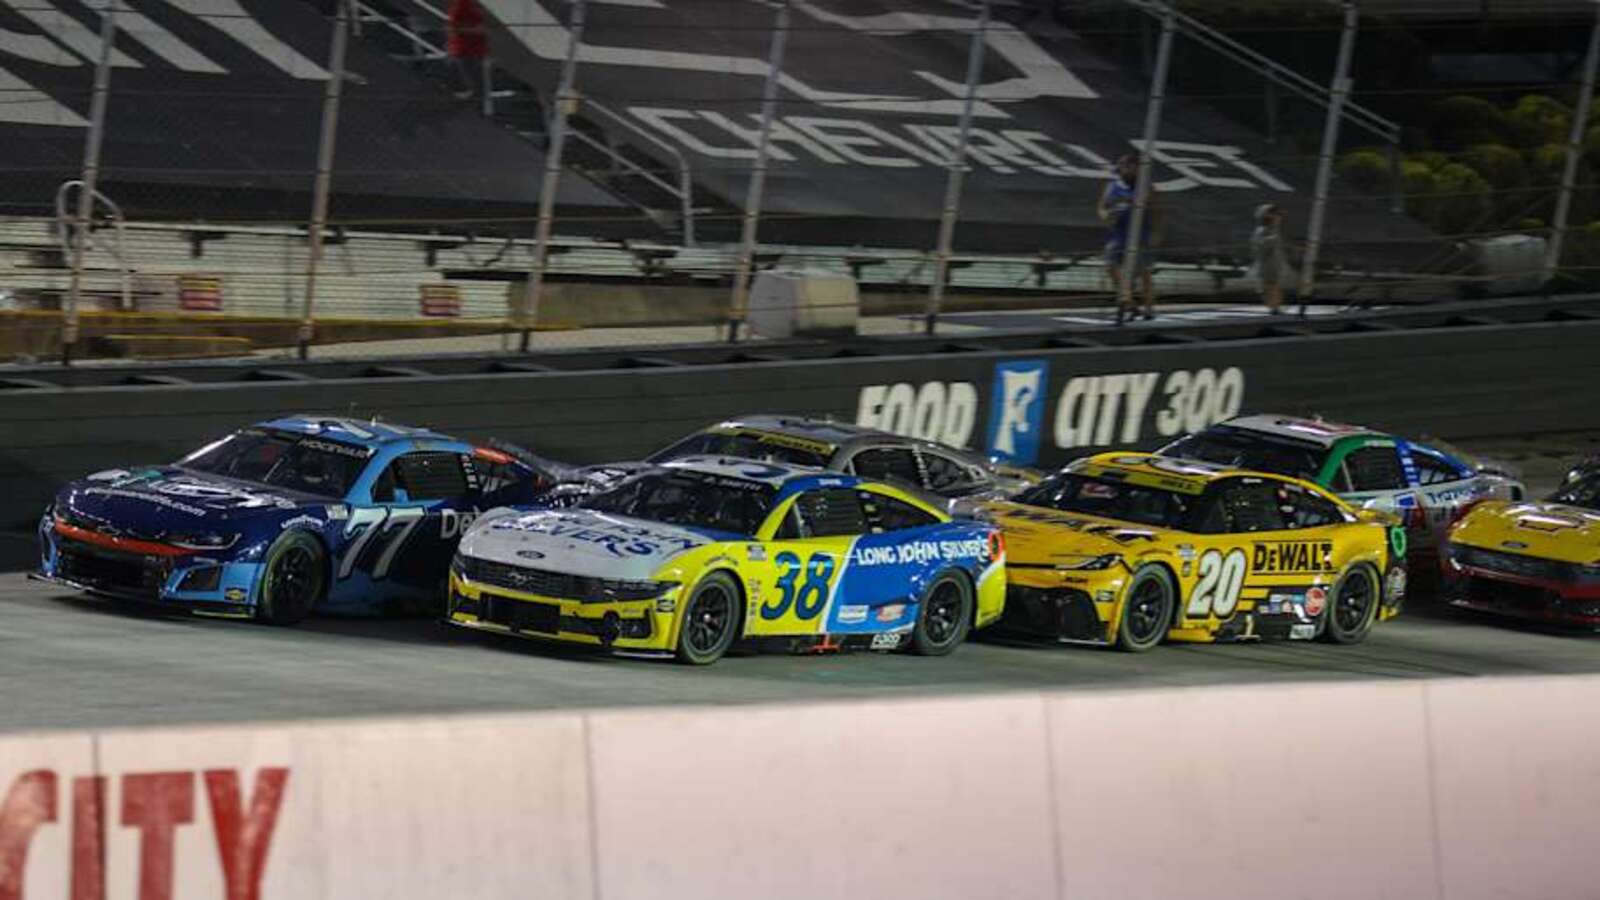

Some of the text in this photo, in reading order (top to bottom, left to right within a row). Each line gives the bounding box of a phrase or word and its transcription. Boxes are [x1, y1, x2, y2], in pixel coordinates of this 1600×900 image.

[857, 381, 978, 449] FOOD
[1054, 373, 1160, 448] CITY
[1156, 367, 1244, 437] 300
[337, 506, 425, 580] 77
[856, 545, 898, 566] LONG
[898, 541, 941, 566] JOHN
[760, 551, 835, 621] 38
[1187, 548, 1247, 619] 20
[0, 766, 291, 900] CITY
